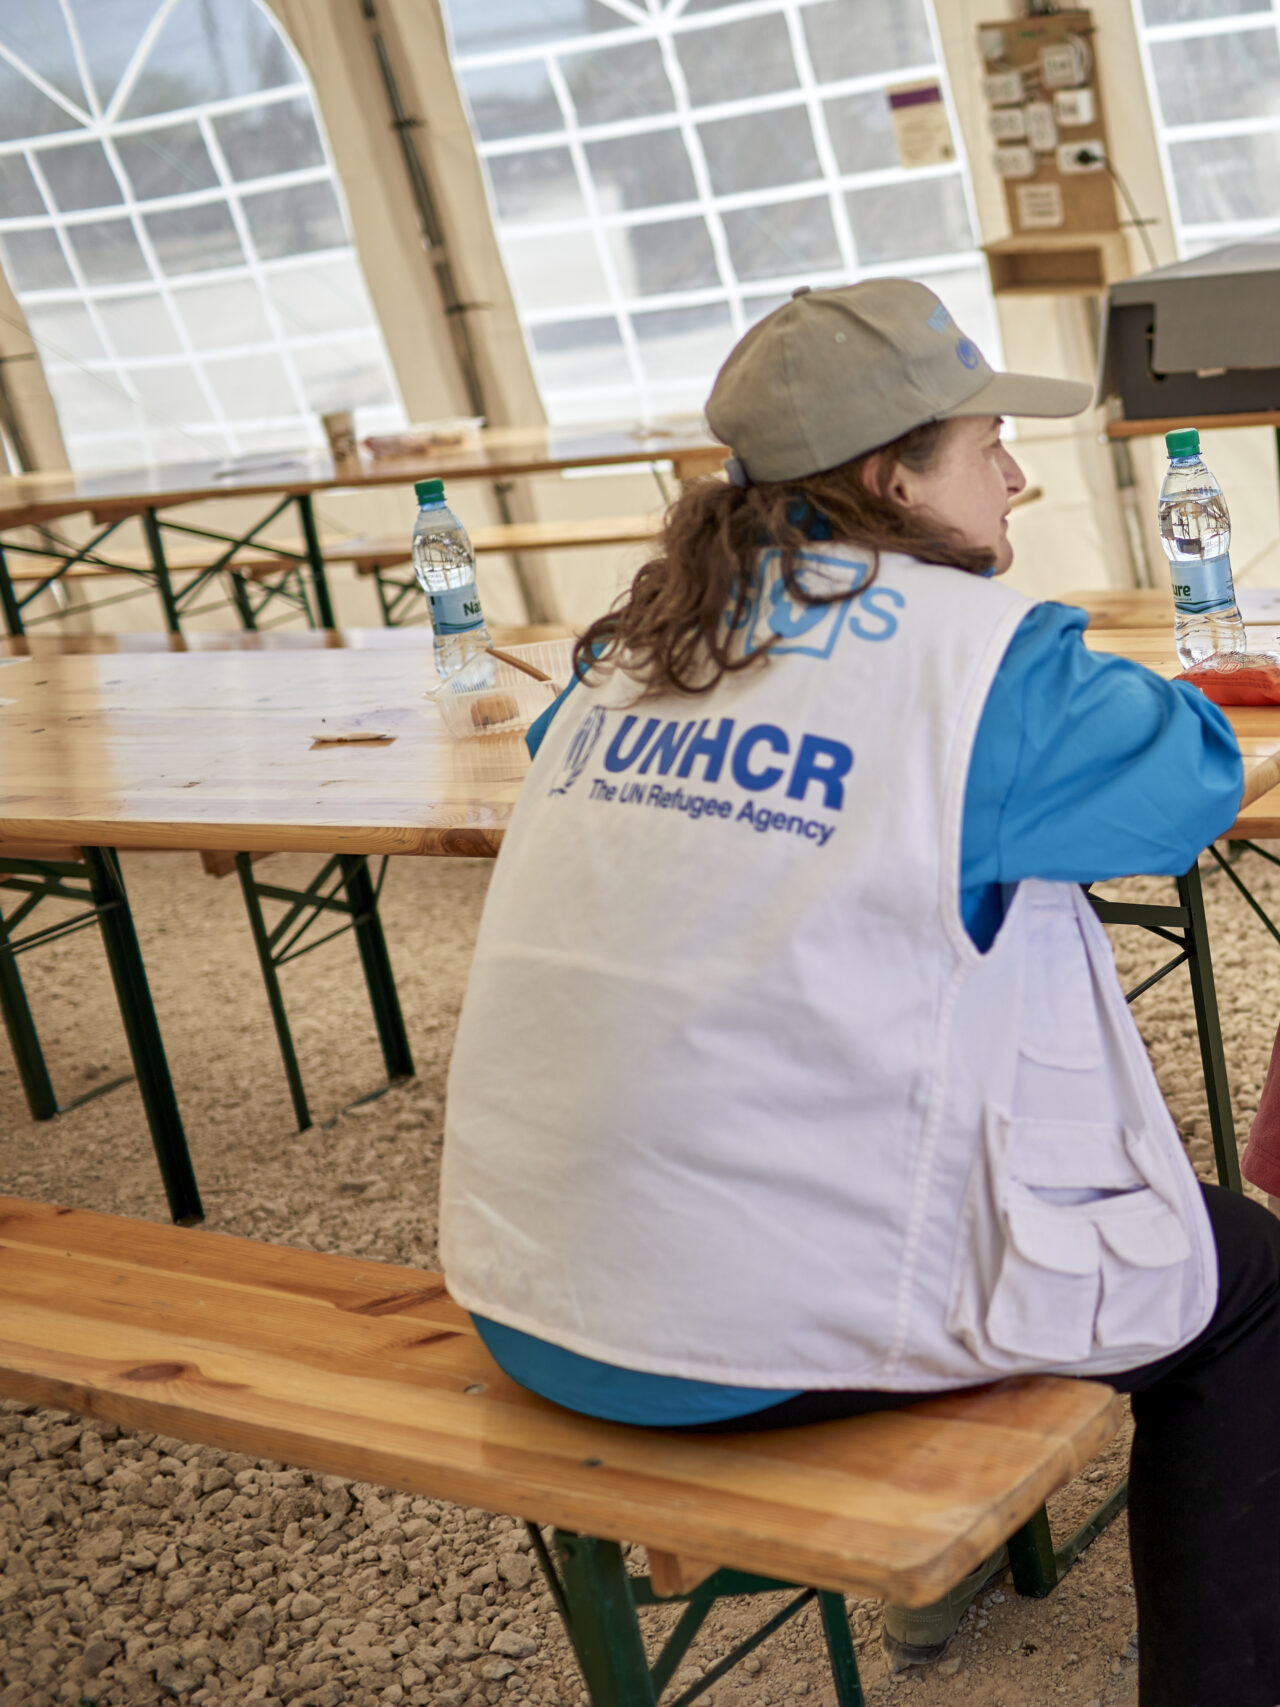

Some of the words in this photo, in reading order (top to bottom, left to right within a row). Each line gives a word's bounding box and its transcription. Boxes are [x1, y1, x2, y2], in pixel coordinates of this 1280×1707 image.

[848, 586, 906, 642] S
[604, 715, 854, 811] UNHCR
[589, 779, 617, 803] The
[619, 781, 645, 806] UN
[646, 784, 732, 820] Refugee
[736, 800, 836, 848] Agency
